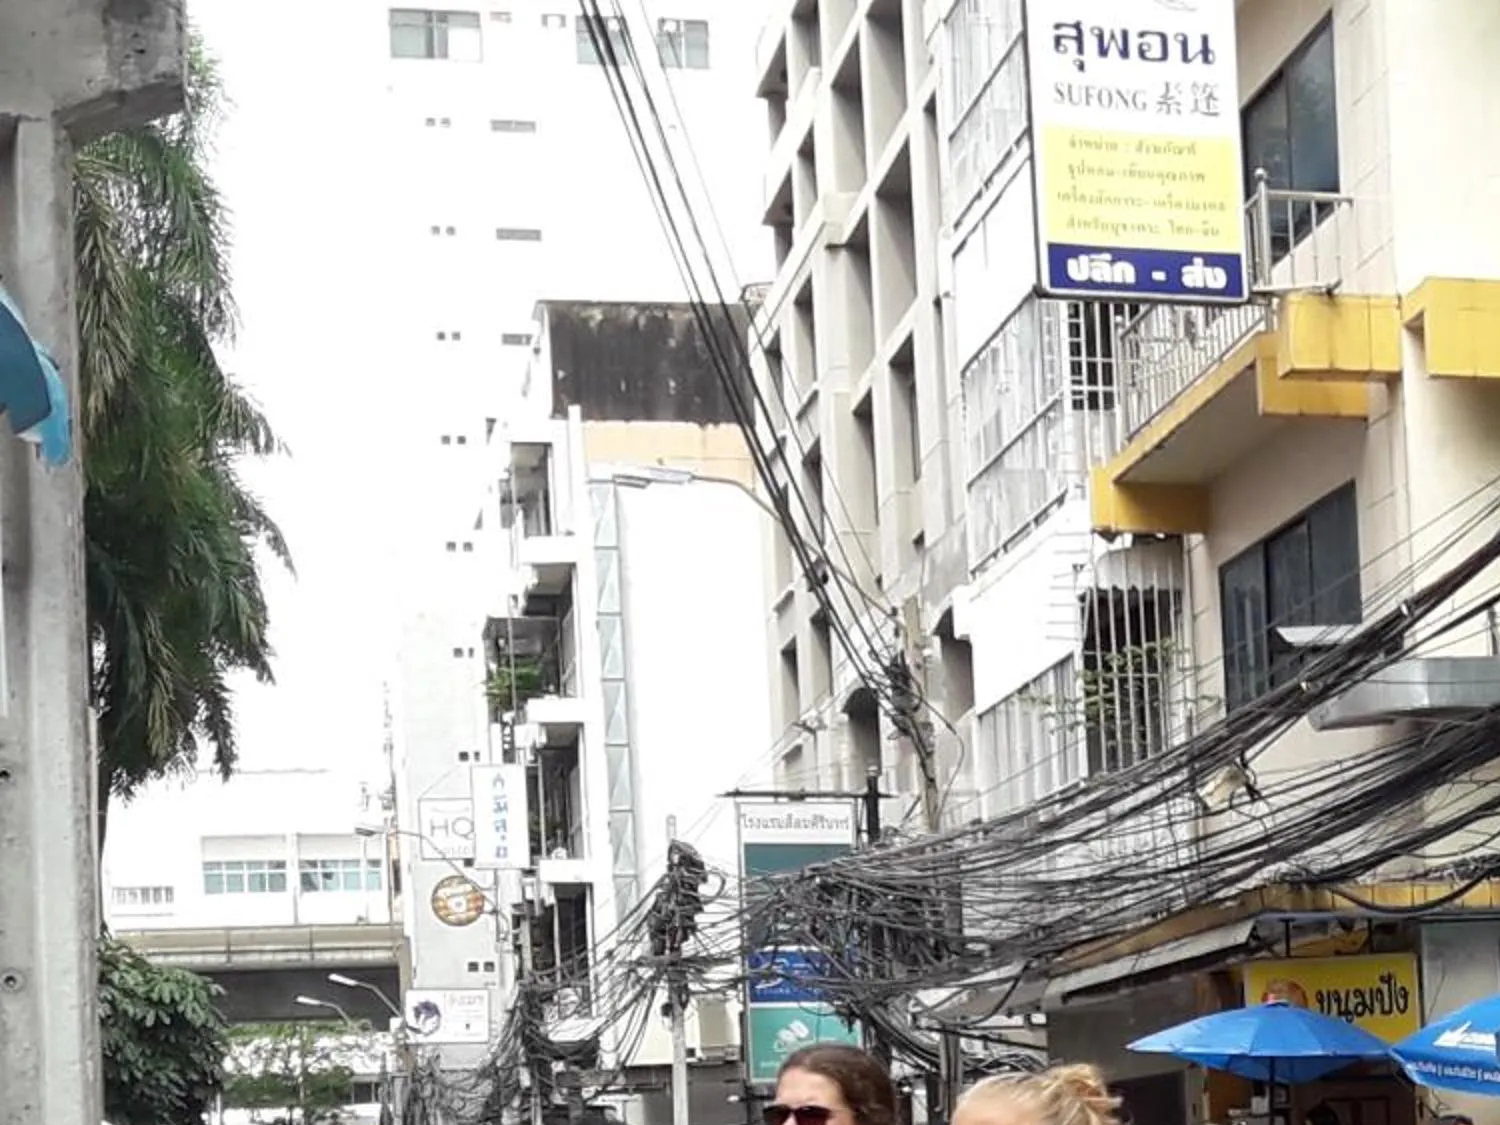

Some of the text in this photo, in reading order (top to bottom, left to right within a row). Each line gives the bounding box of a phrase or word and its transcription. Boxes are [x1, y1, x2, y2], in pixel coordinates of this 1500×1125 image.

[1052, 20, 1216, 73] สุพอน
[1053, 82, 1147, 112] SUFONG
[1066, 253, 1136, 284] ปลีก
[1180, 257, 1228, 289] ส่ง
[1315, 970, 1410, 1023] ขนมปัง
